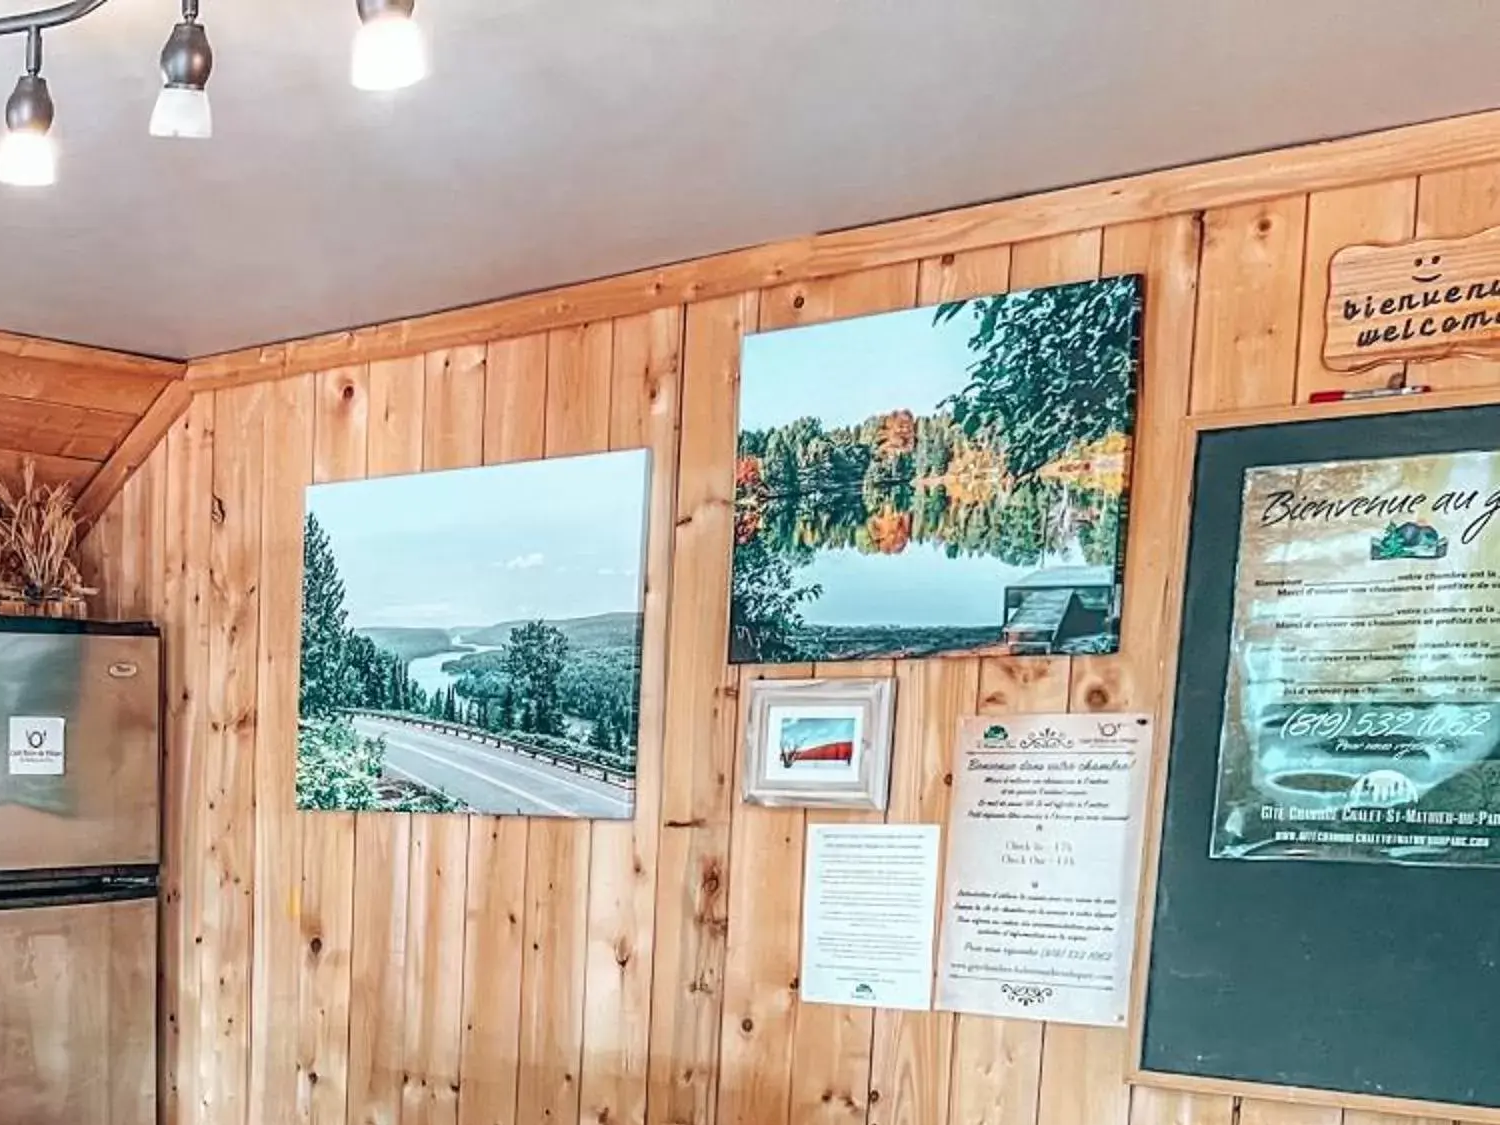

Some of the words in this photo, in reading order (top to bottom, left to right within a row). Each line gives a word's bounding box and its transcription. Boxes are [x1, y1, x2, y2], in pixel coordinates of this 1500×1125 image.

[1261, 490, 1427, 529] Bienvenue
[1432, 489, 1479, 514] au
[1281, 706, 1352, 740] (819)
[1353, 711, 1415, 736] 532
[1417, 711, 1492, 737] 1062
